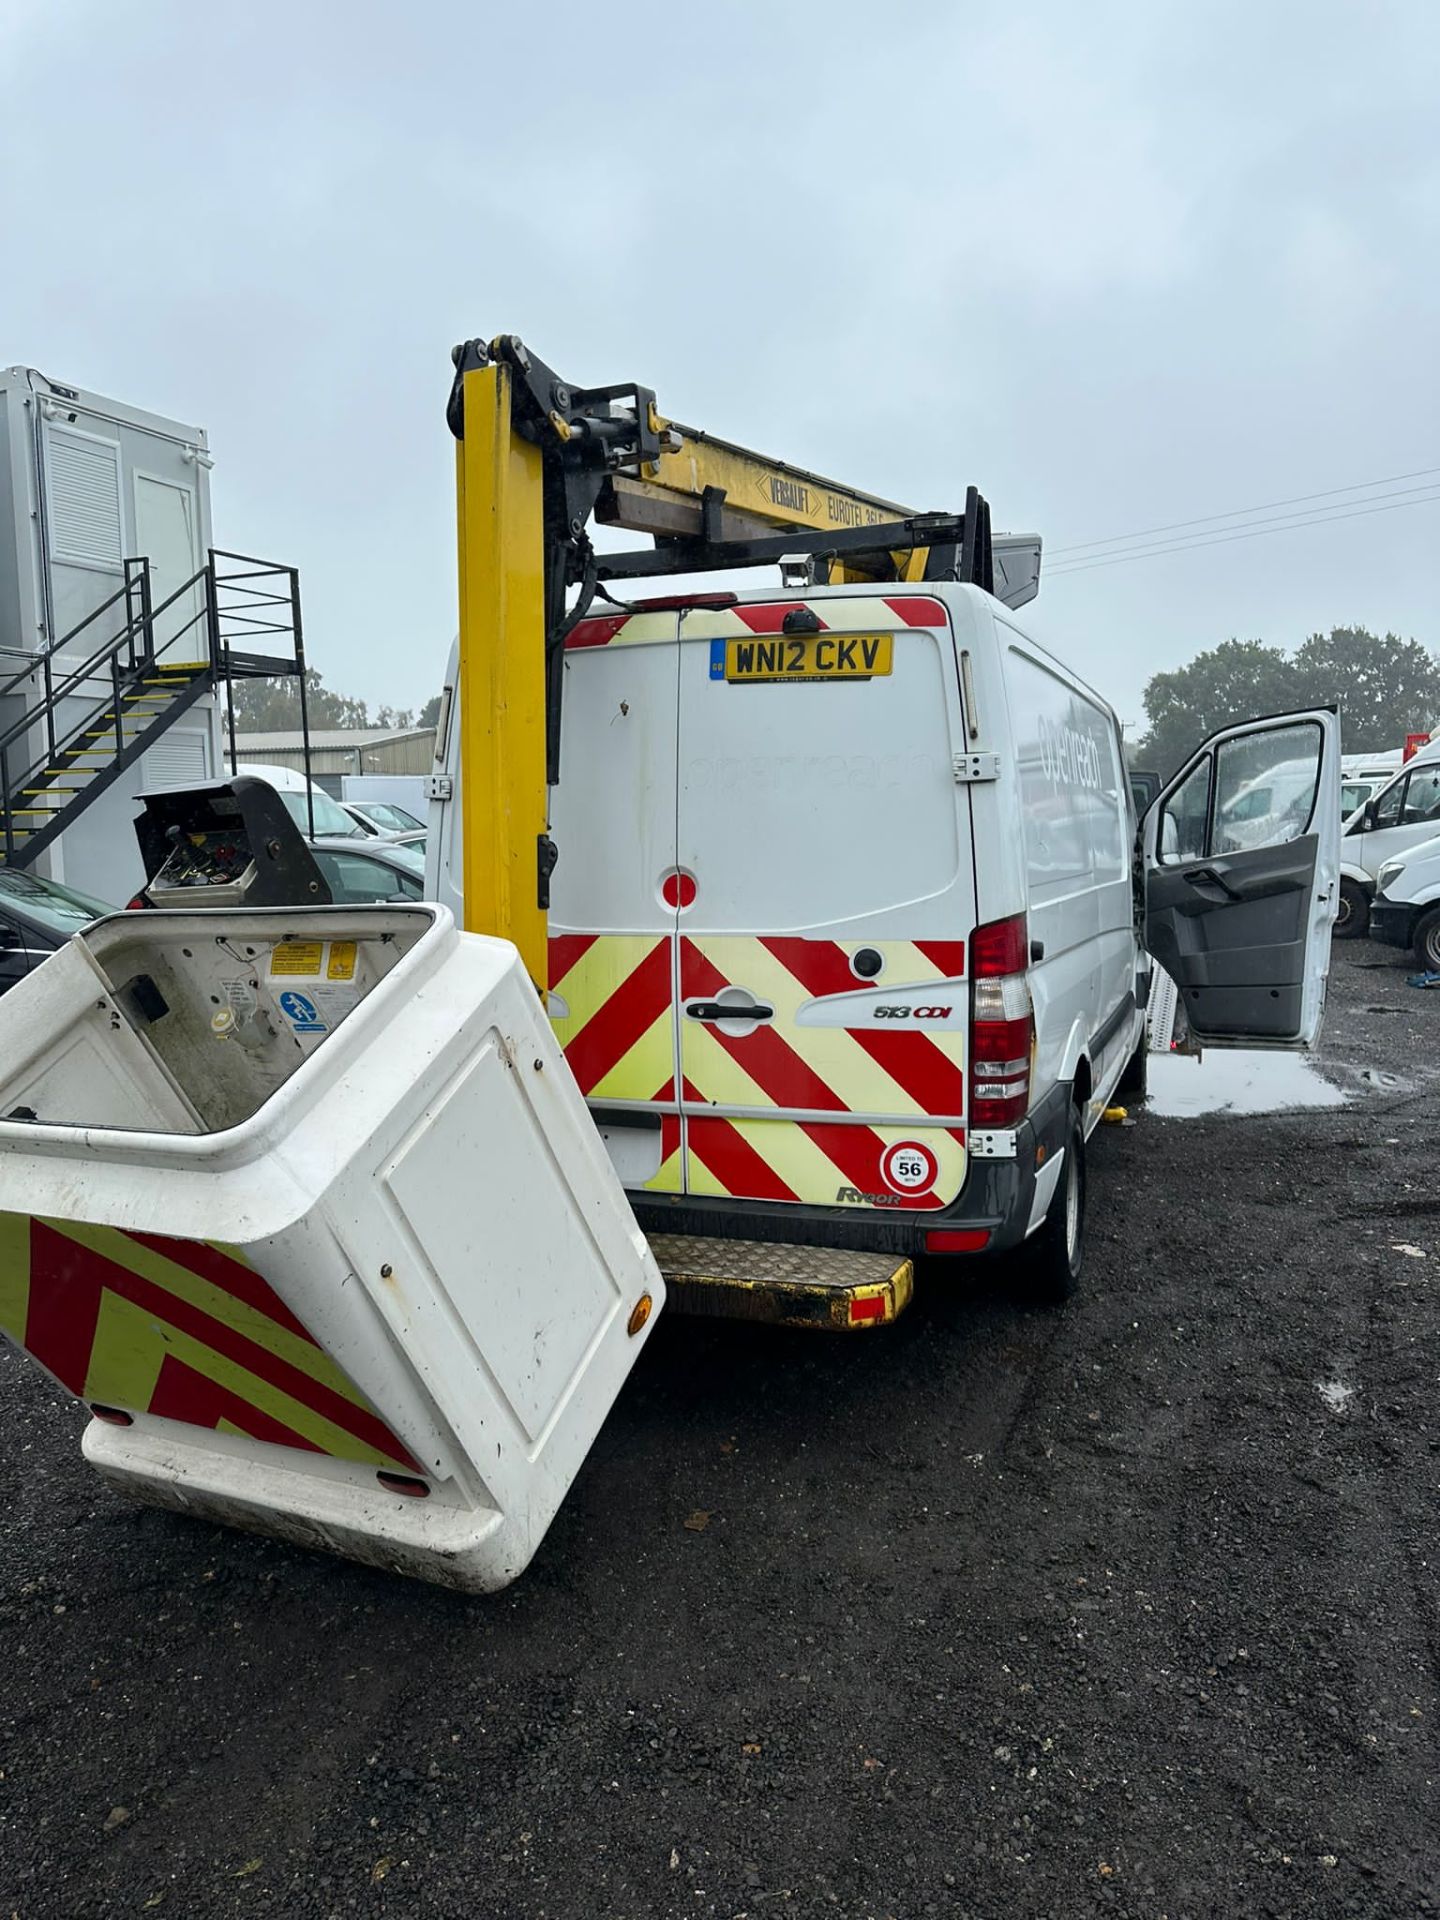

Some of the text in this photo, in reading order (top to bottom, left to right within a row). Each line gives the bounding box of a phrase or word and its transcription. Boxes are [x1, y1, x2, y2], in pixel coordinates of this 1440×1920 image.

[770, 476, 809, 514] VERSALIFT
[828, 495, 863, 527] EUROTEL
[737, 638, 880, 673] WN12 CKV
[873, 1005, 953, 1019] 513 CDI
[898, 1162, 922, 1177] 56
